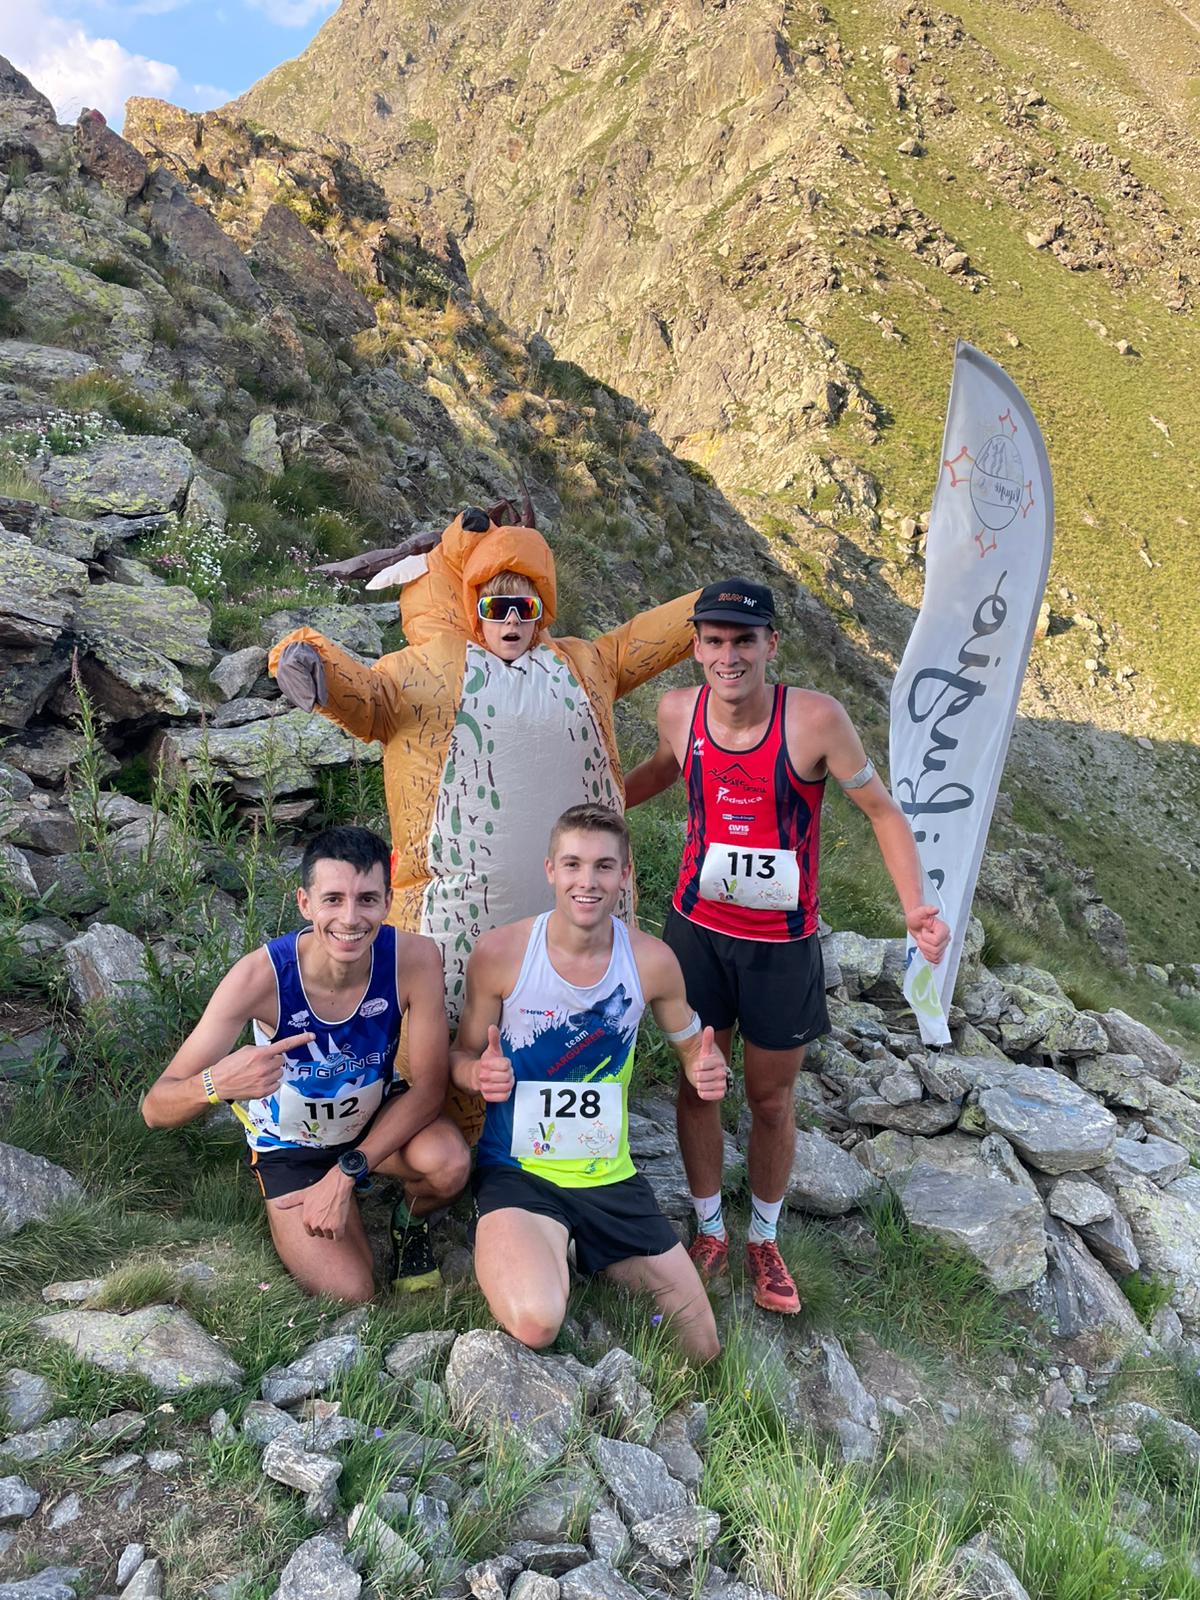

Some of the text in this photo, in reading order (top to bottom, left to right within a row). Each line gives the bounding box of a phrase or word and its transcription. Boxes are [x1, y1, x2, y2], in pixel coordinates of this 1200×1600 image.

[727, 851, 777, 880] 113
[564, 1030, 590, 1049] team
[304, 1096, 360, 1121] 112
[539, 1088, 601, 1119] 128
